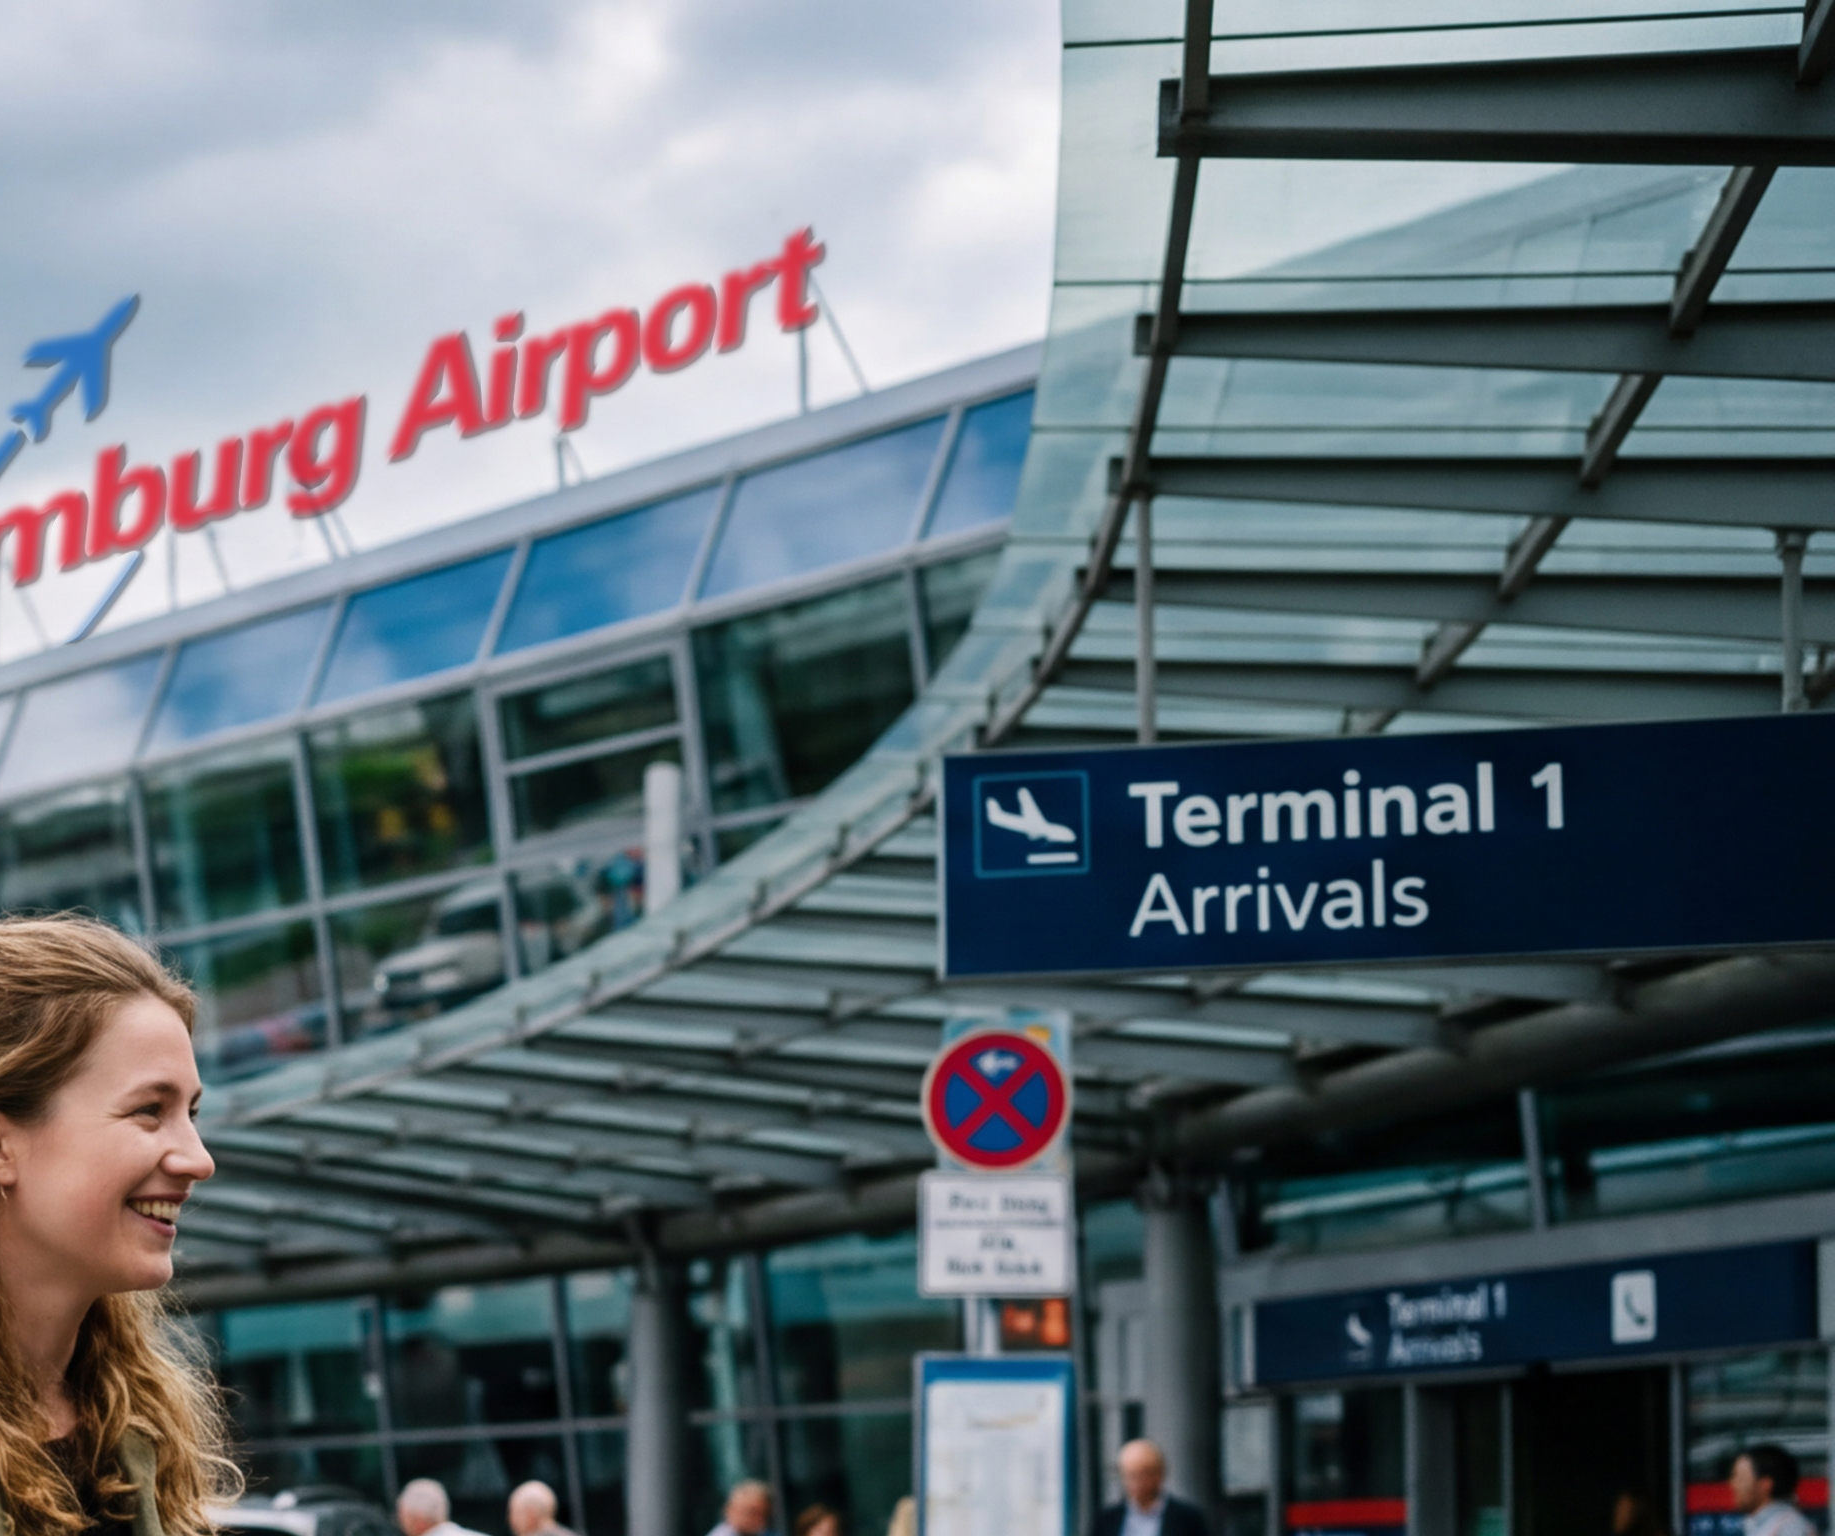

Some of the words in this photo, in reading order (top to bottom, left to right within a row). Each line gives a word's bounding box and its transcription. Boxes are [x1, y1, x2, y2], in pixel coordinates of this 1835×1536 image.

[387, 228, 825, 460] Airport
[1127, 760, 1497, 848] Terminal
[1530, 761, 1565, 830] 1
[1128, 857, 1430, 938] Arrivals
[1387, 1283, 1490, 1328] Terminal
[1492, 1281, 1508, 1319] 1
